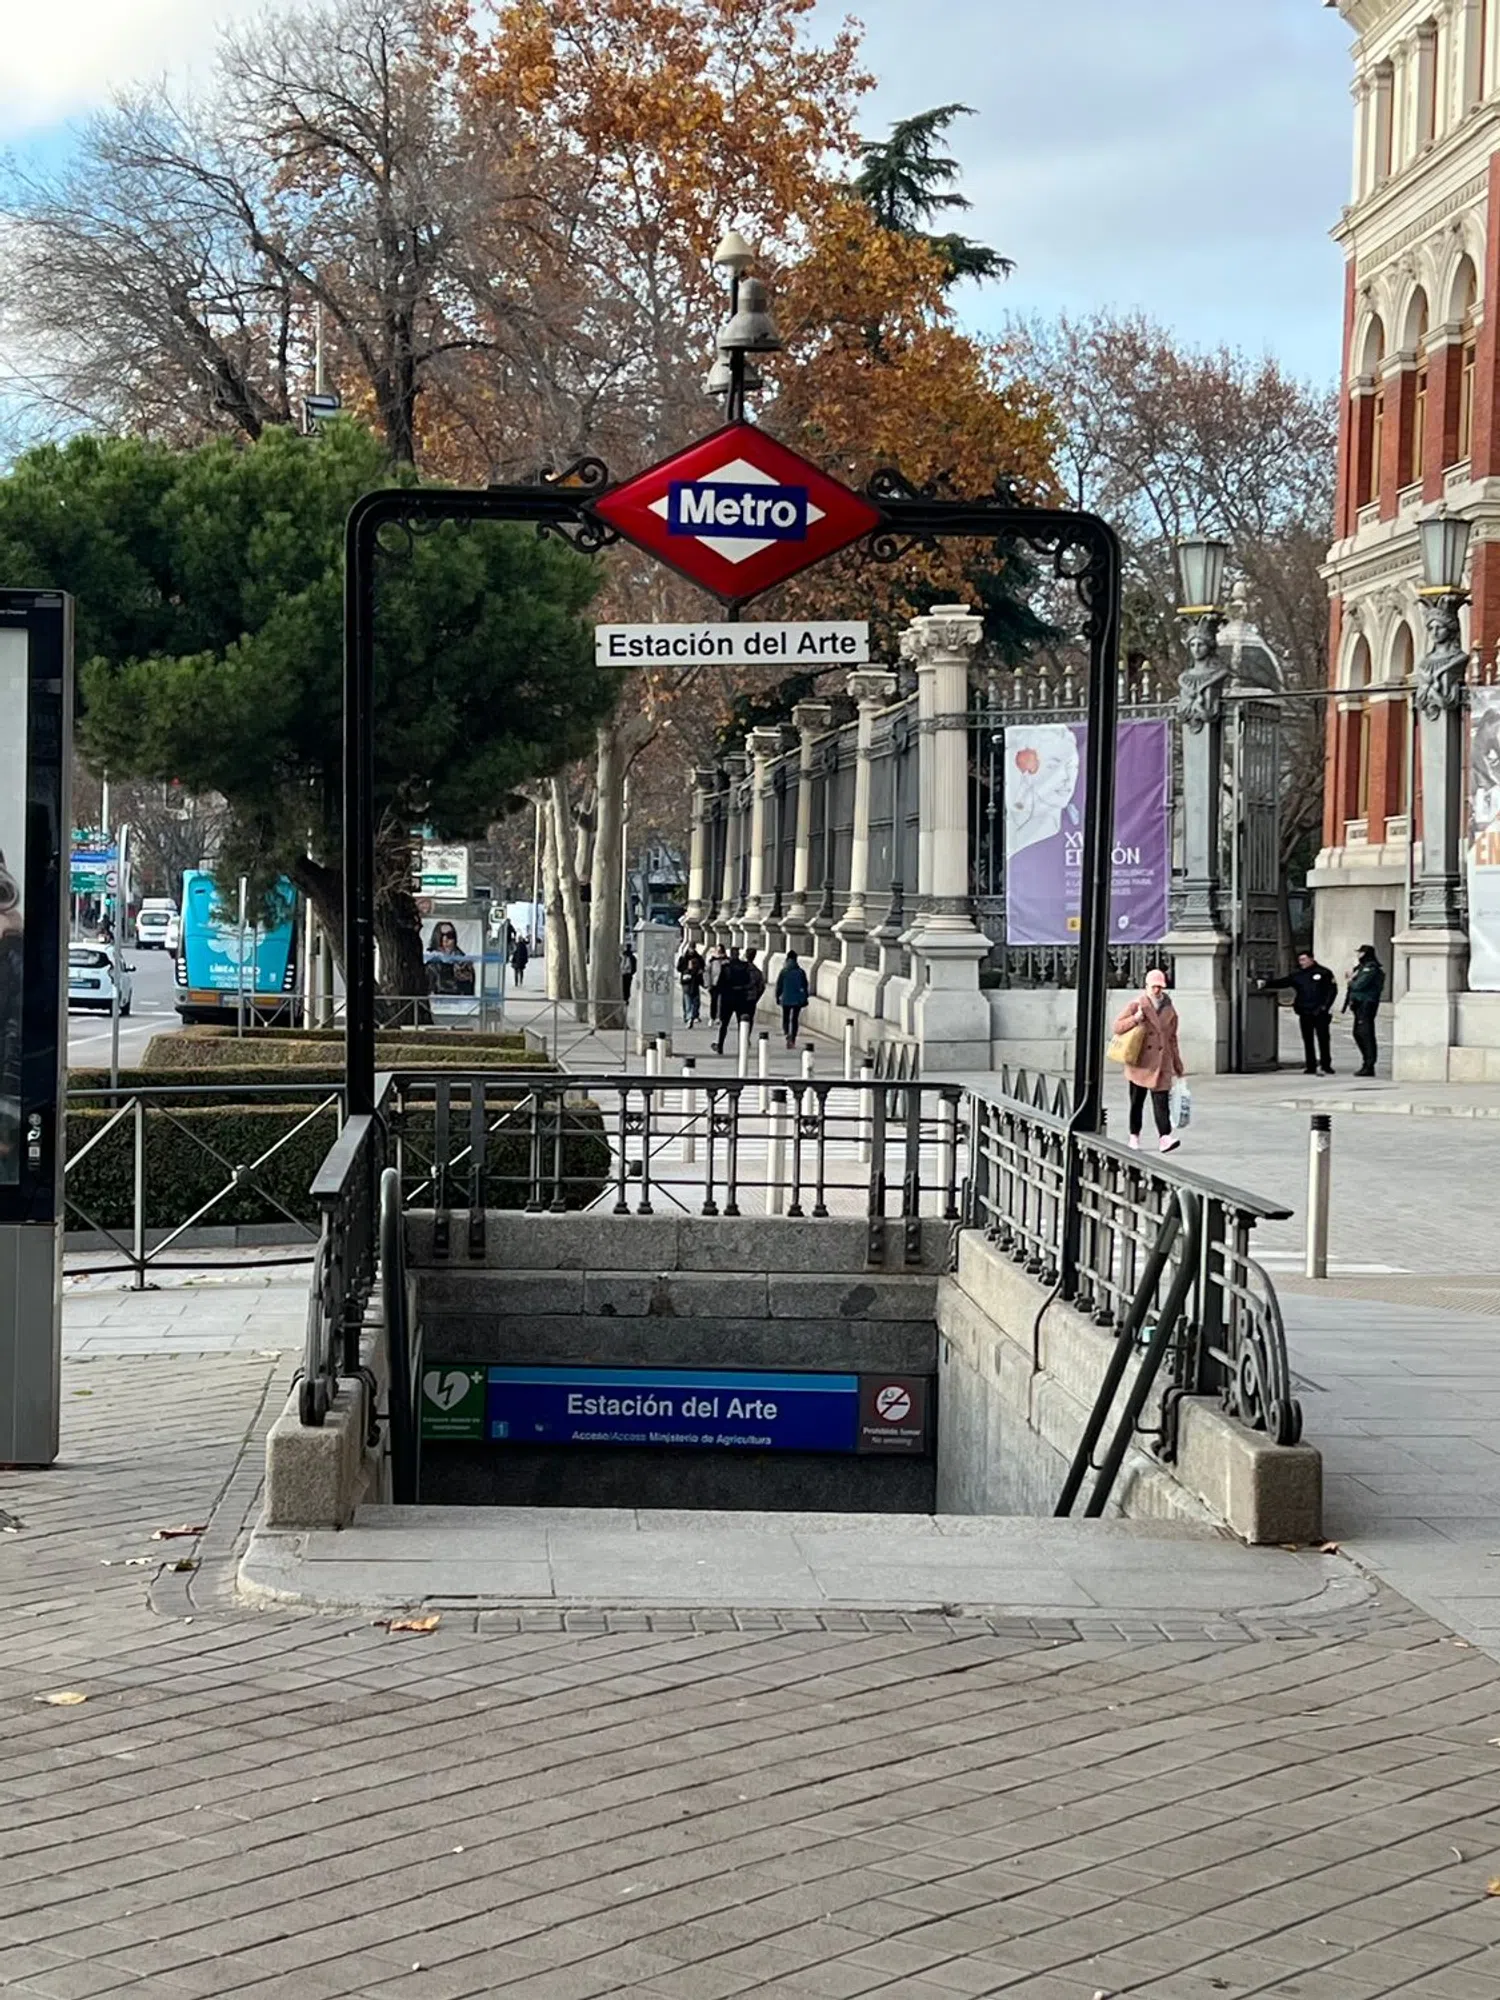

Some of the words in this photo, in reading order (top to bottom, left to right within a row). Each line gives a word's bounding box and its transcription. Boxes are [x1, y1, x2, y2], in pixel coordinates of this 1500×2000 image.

[679, 488, 798, 528] Metro
[608, 631, 733, 658] Estación
[743, 631, 787, 655] del
[797, 631, 857, 655] Arte
[567, 1393, 674, 1417] Estación
[681, 1396, 719, 1418] del
[726, 1397, 778, 1420] Arte
[701, 1434, 714, 1443] de
[716, 1434, 772, 1446] Agricultura
